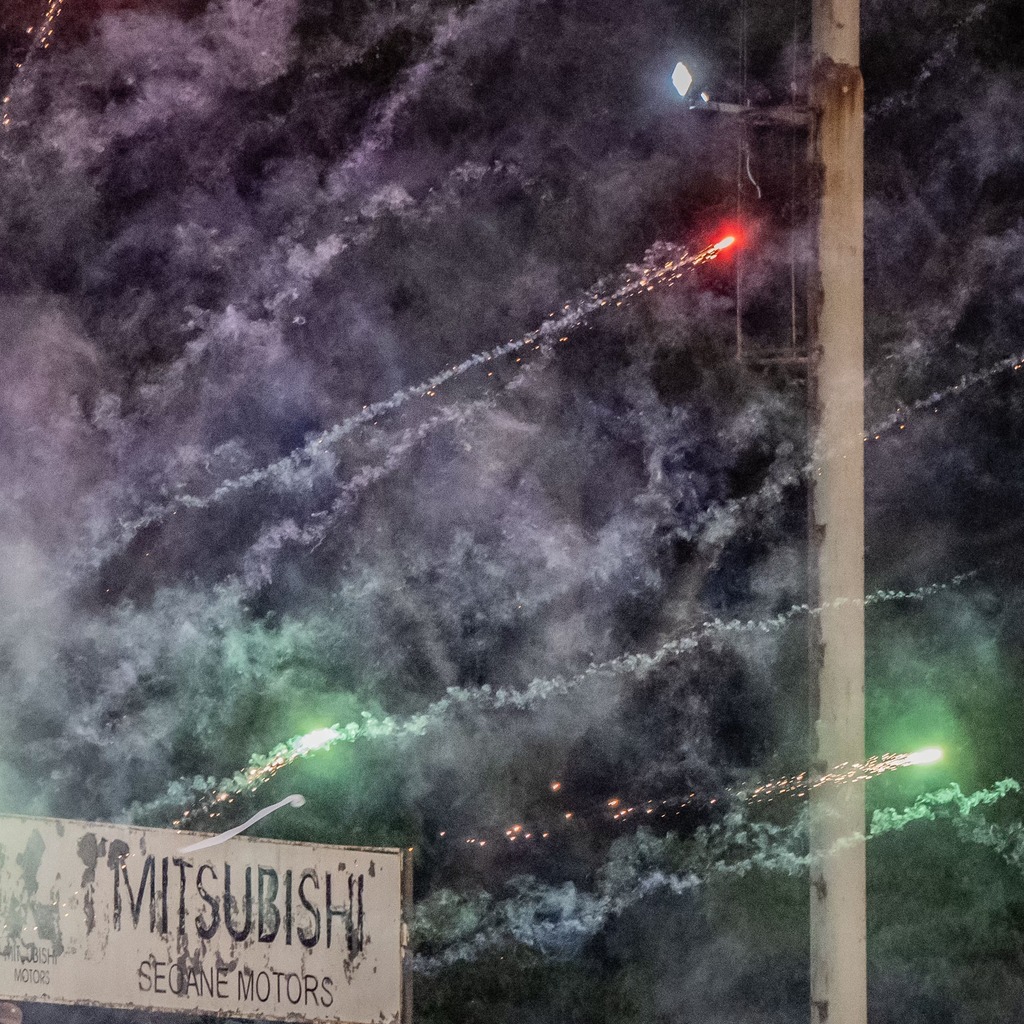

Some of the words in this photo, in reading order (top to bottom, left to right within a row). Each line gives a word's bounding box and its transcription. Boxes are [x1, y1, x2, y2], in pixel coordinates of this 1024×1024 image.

[112, 855, 365, 951] MITSUBISHI
[14, 968, 51, 985] MOTORS
[138, 960, 229, 999] SEOANE
[237, 970, 334, 1008] MOTORS
